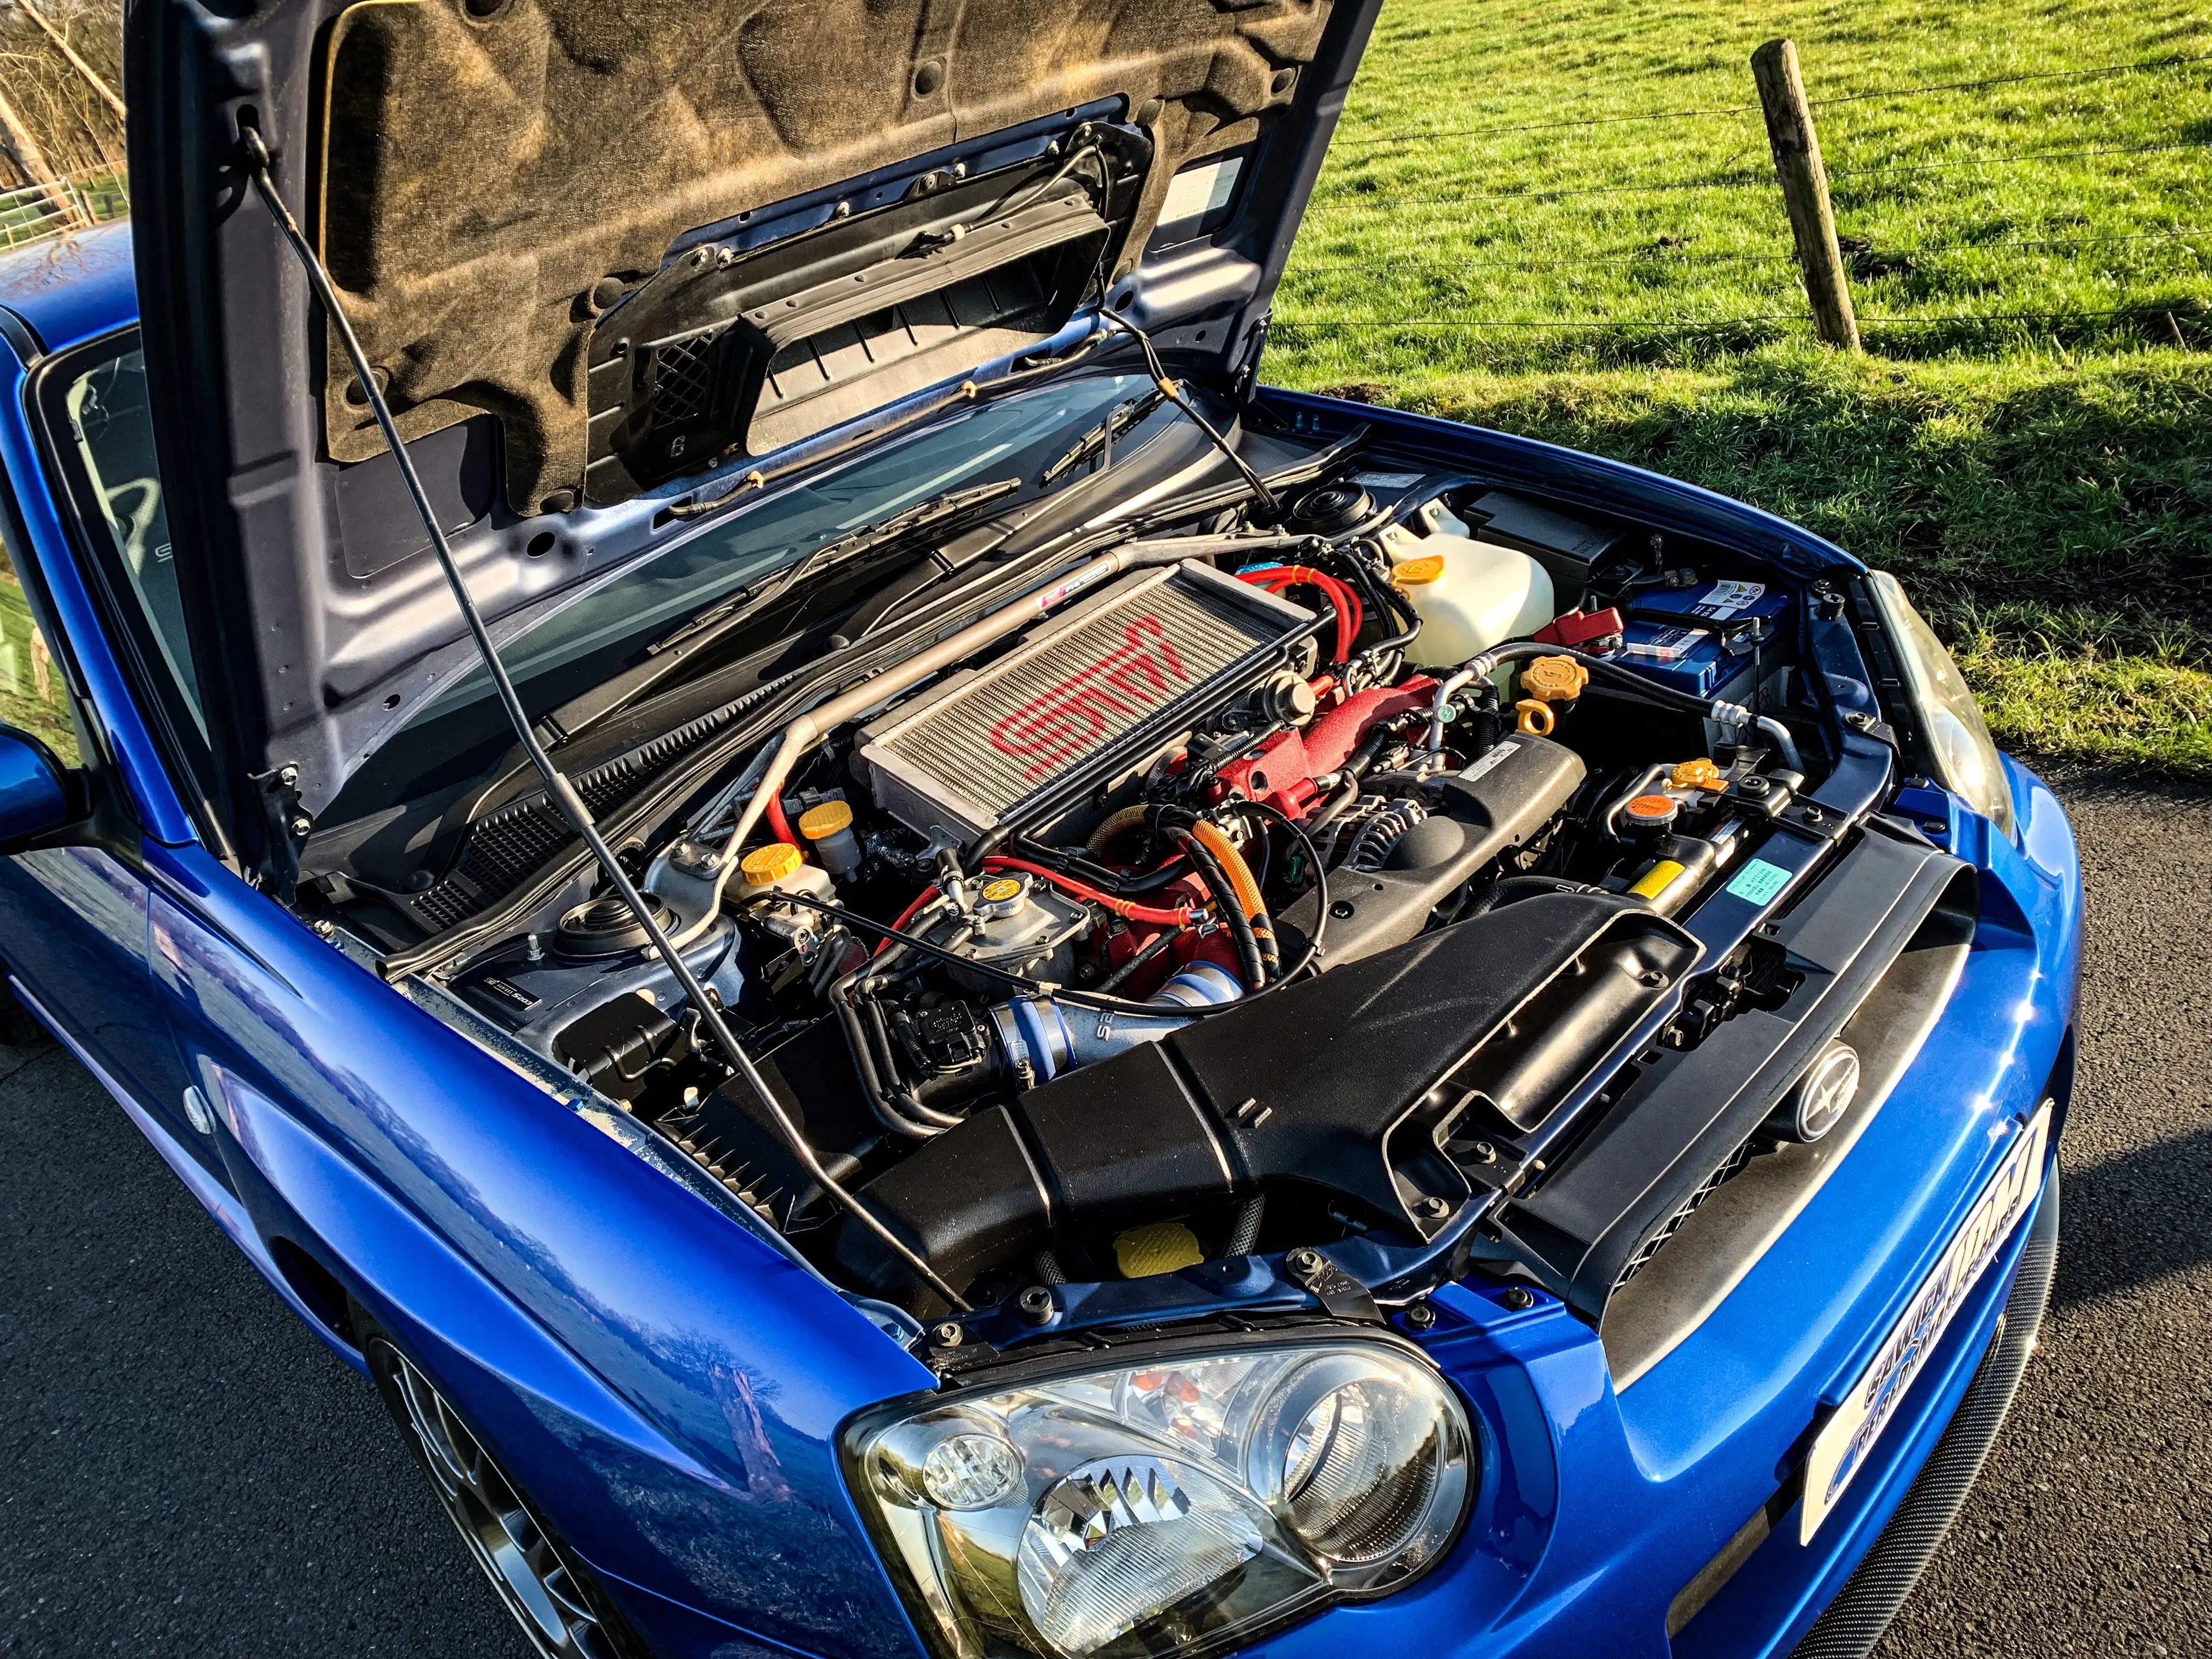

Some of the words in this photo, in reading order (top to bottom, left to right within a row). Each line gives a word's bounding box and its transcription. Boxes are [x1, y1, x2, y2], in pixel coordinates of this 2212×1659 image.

[512, 993, 533, 1006] S203
[1945, 1126, 2037, 1302] JDM
[1853, 1257, 1975, 1465] PERFORMANCE
[1974, 1190, 2020, 1274] CARS
[1864, 1255, 1953, 1411] SAWICKI
